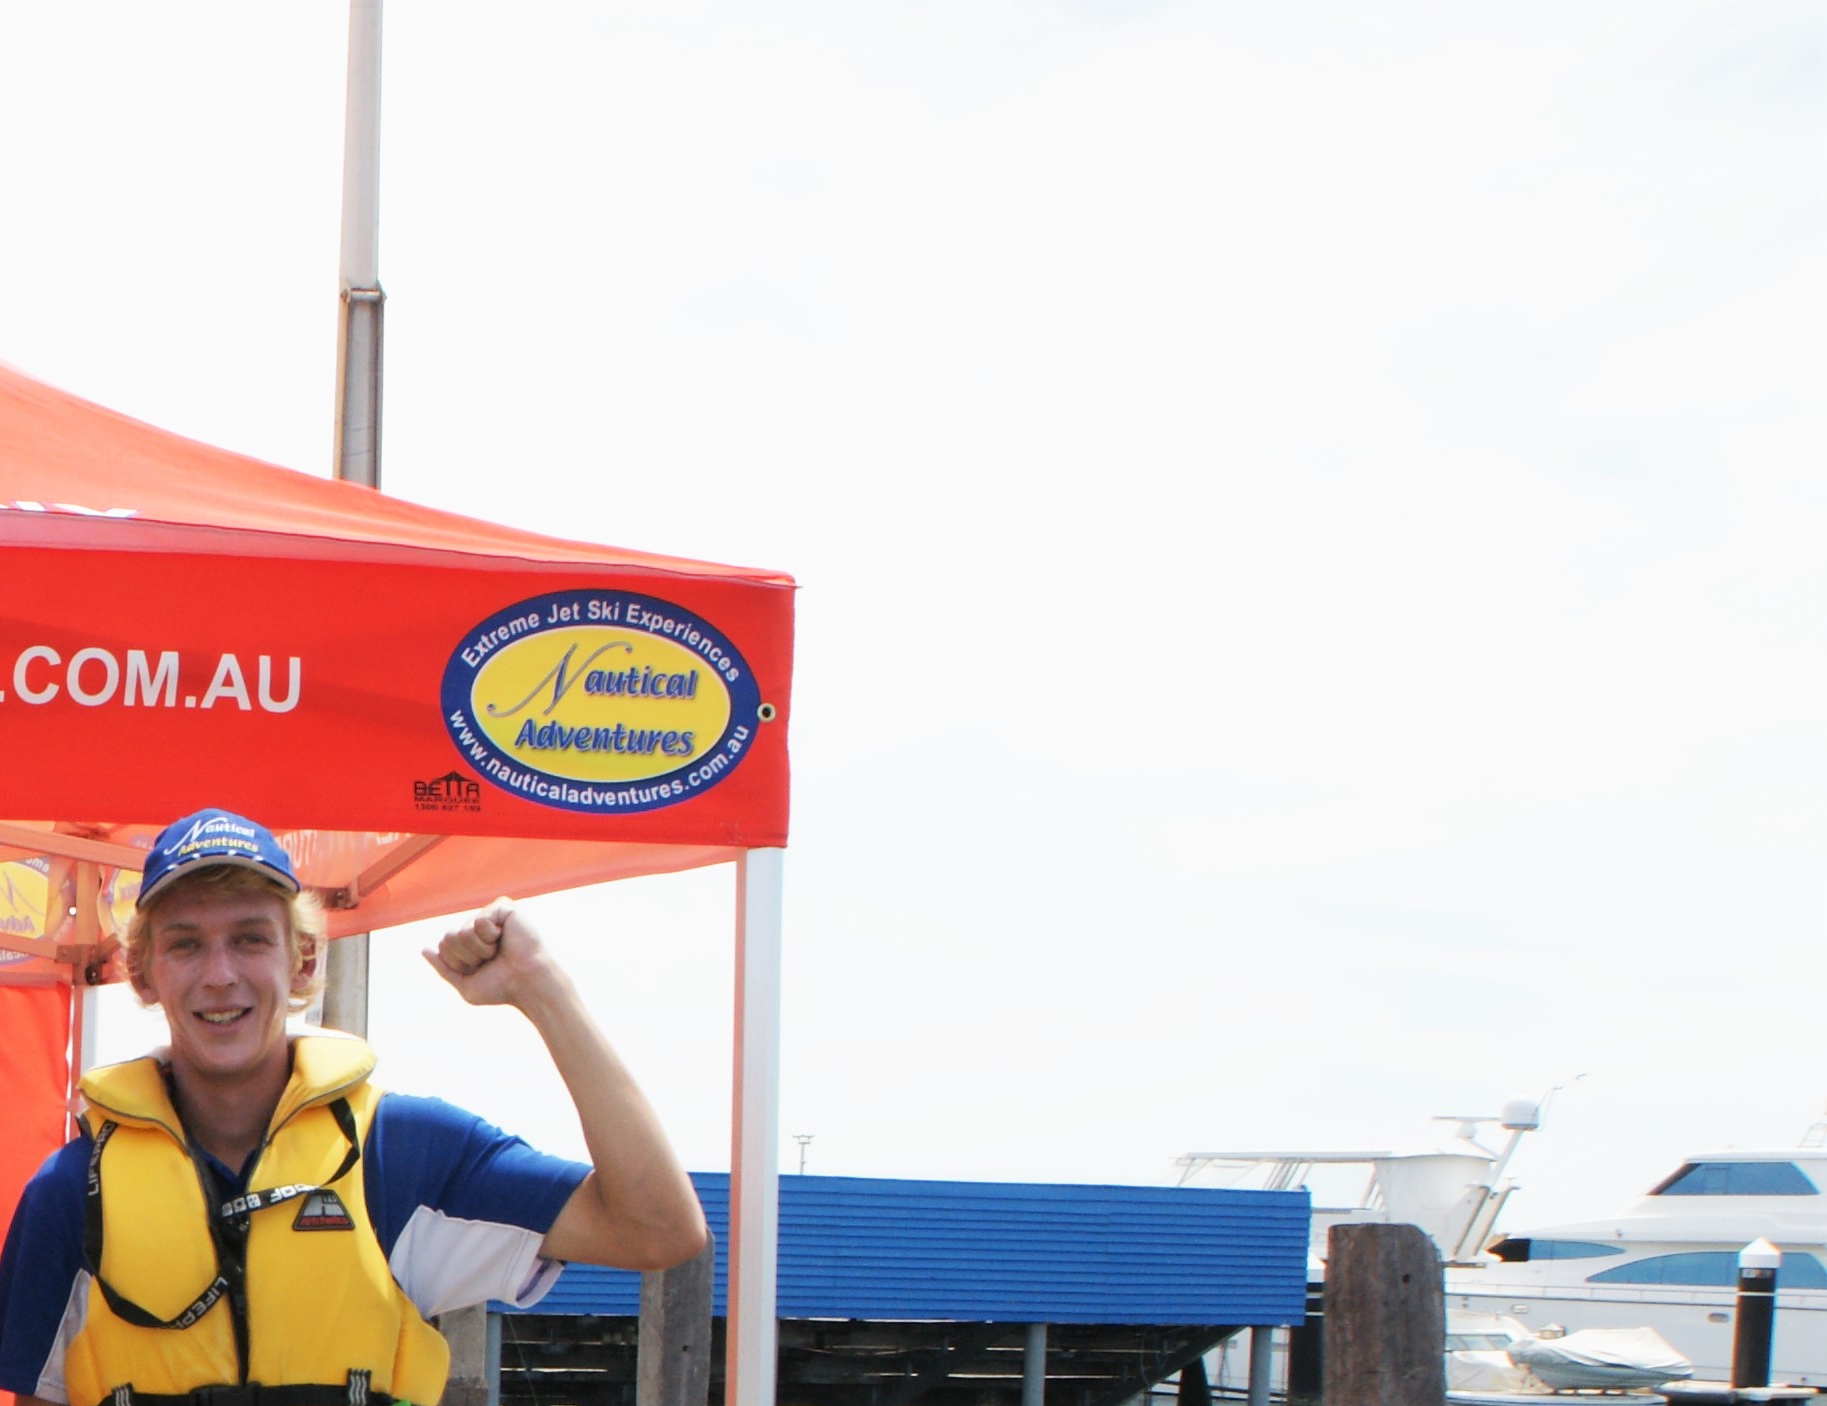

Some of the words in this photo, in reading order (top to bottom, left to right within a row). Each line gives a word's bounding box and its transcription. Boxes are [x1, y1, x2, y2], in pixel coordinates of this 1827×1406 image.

[460, 611, 540, 669] Extreme
[547, 602, 580, 623] Jet
[588, 600, 620, 621] Ski
[626, 603, 741, 683] Experiences
[487, 641, 697, 717] Nautical
[450, 708, 749, 806] www.nauticaladventures.com.au
[514, 719, 694, 755] Adventures
[164, 817, 255, 855] Nautical
[178, 837, 259, 856] Adventures
